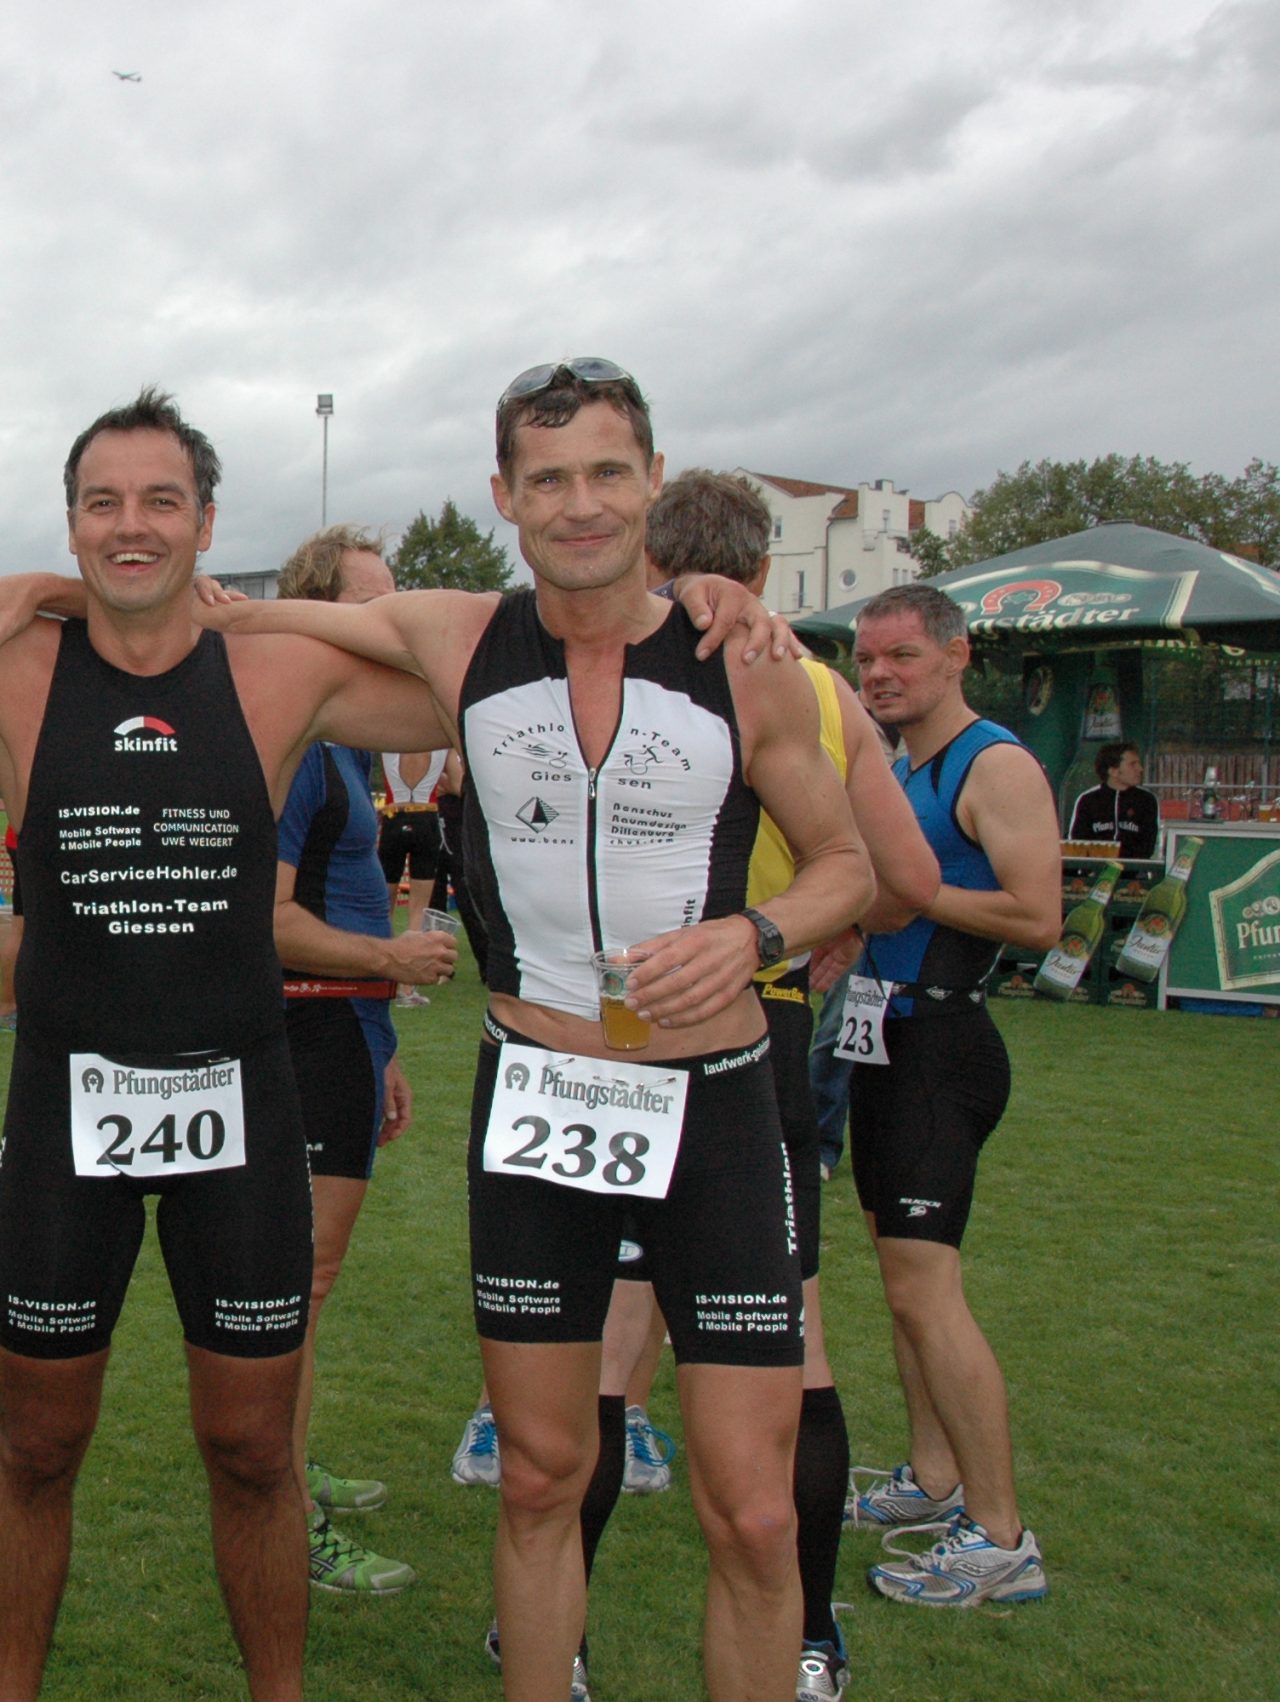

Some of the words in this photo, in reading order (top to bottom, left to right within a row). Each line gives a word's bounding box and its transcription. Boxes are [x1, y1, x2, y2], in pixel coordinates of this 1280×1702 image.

[114, 737, 178, 752] skinfit
[58, 805, 141, 819] IS-VISION.de
[162, 808, 206, 819] FITNESS
[209, 809, 230, 819] UND
[59, 828, 92, 839] Mobile
[94, 825, 142, 837] Software
[153, 822, 240, 834] COMMUNICATION
[60, 842, 67, 850] 4
[68, 839, 102, 850] Mobile
[105, 837, 142, 848] People
[161, 836, 186, 847] UWE
[189, 836, 234, 848] WEIGERT
[60, 865, 238, 884] CarServiceHohler.de
[72, 898, 229, 915] Triathlon-Team
[108, 920, 195, 934] Giessen
[113, 1067, 234, 1100] Pfungstädter
[96, 1109, 226, 1166] 240
[502, 1115, 650, 1186] 238
[476, 1273, 560, 1289] IS-VISION.de
[8, 1294, 96, 1311] IS-VISION.de
[216, 1295, 301, 1309] IS-VISION.de
[509, 1295, 560, 1304] Software
[695, 1293, 787, 1304] IS-VISION.de
[483, 1301, 516, 1314] Mobile
[521, 1305, 561, 1315] People
[8, 1309, 44, 1324] Mobile
[49, 1314, 96, 1325] Software
[215, 1311, 251, 1323] Mobile
[256, 1310, 300, 1323] Software
[696, 1310, 731, 1320] Mobile
[735, 1311, 788, 1321] Software
[17, 1320, 55, 1333] Mobile
[60, 1322, 95, 1333] People
[224, 1321, 262, 1332] Mobile
[265, 1319, 298, 1331] People
[705, 1321, 742, 1331] Mobile
[747, 1322, 788, 1333] People
